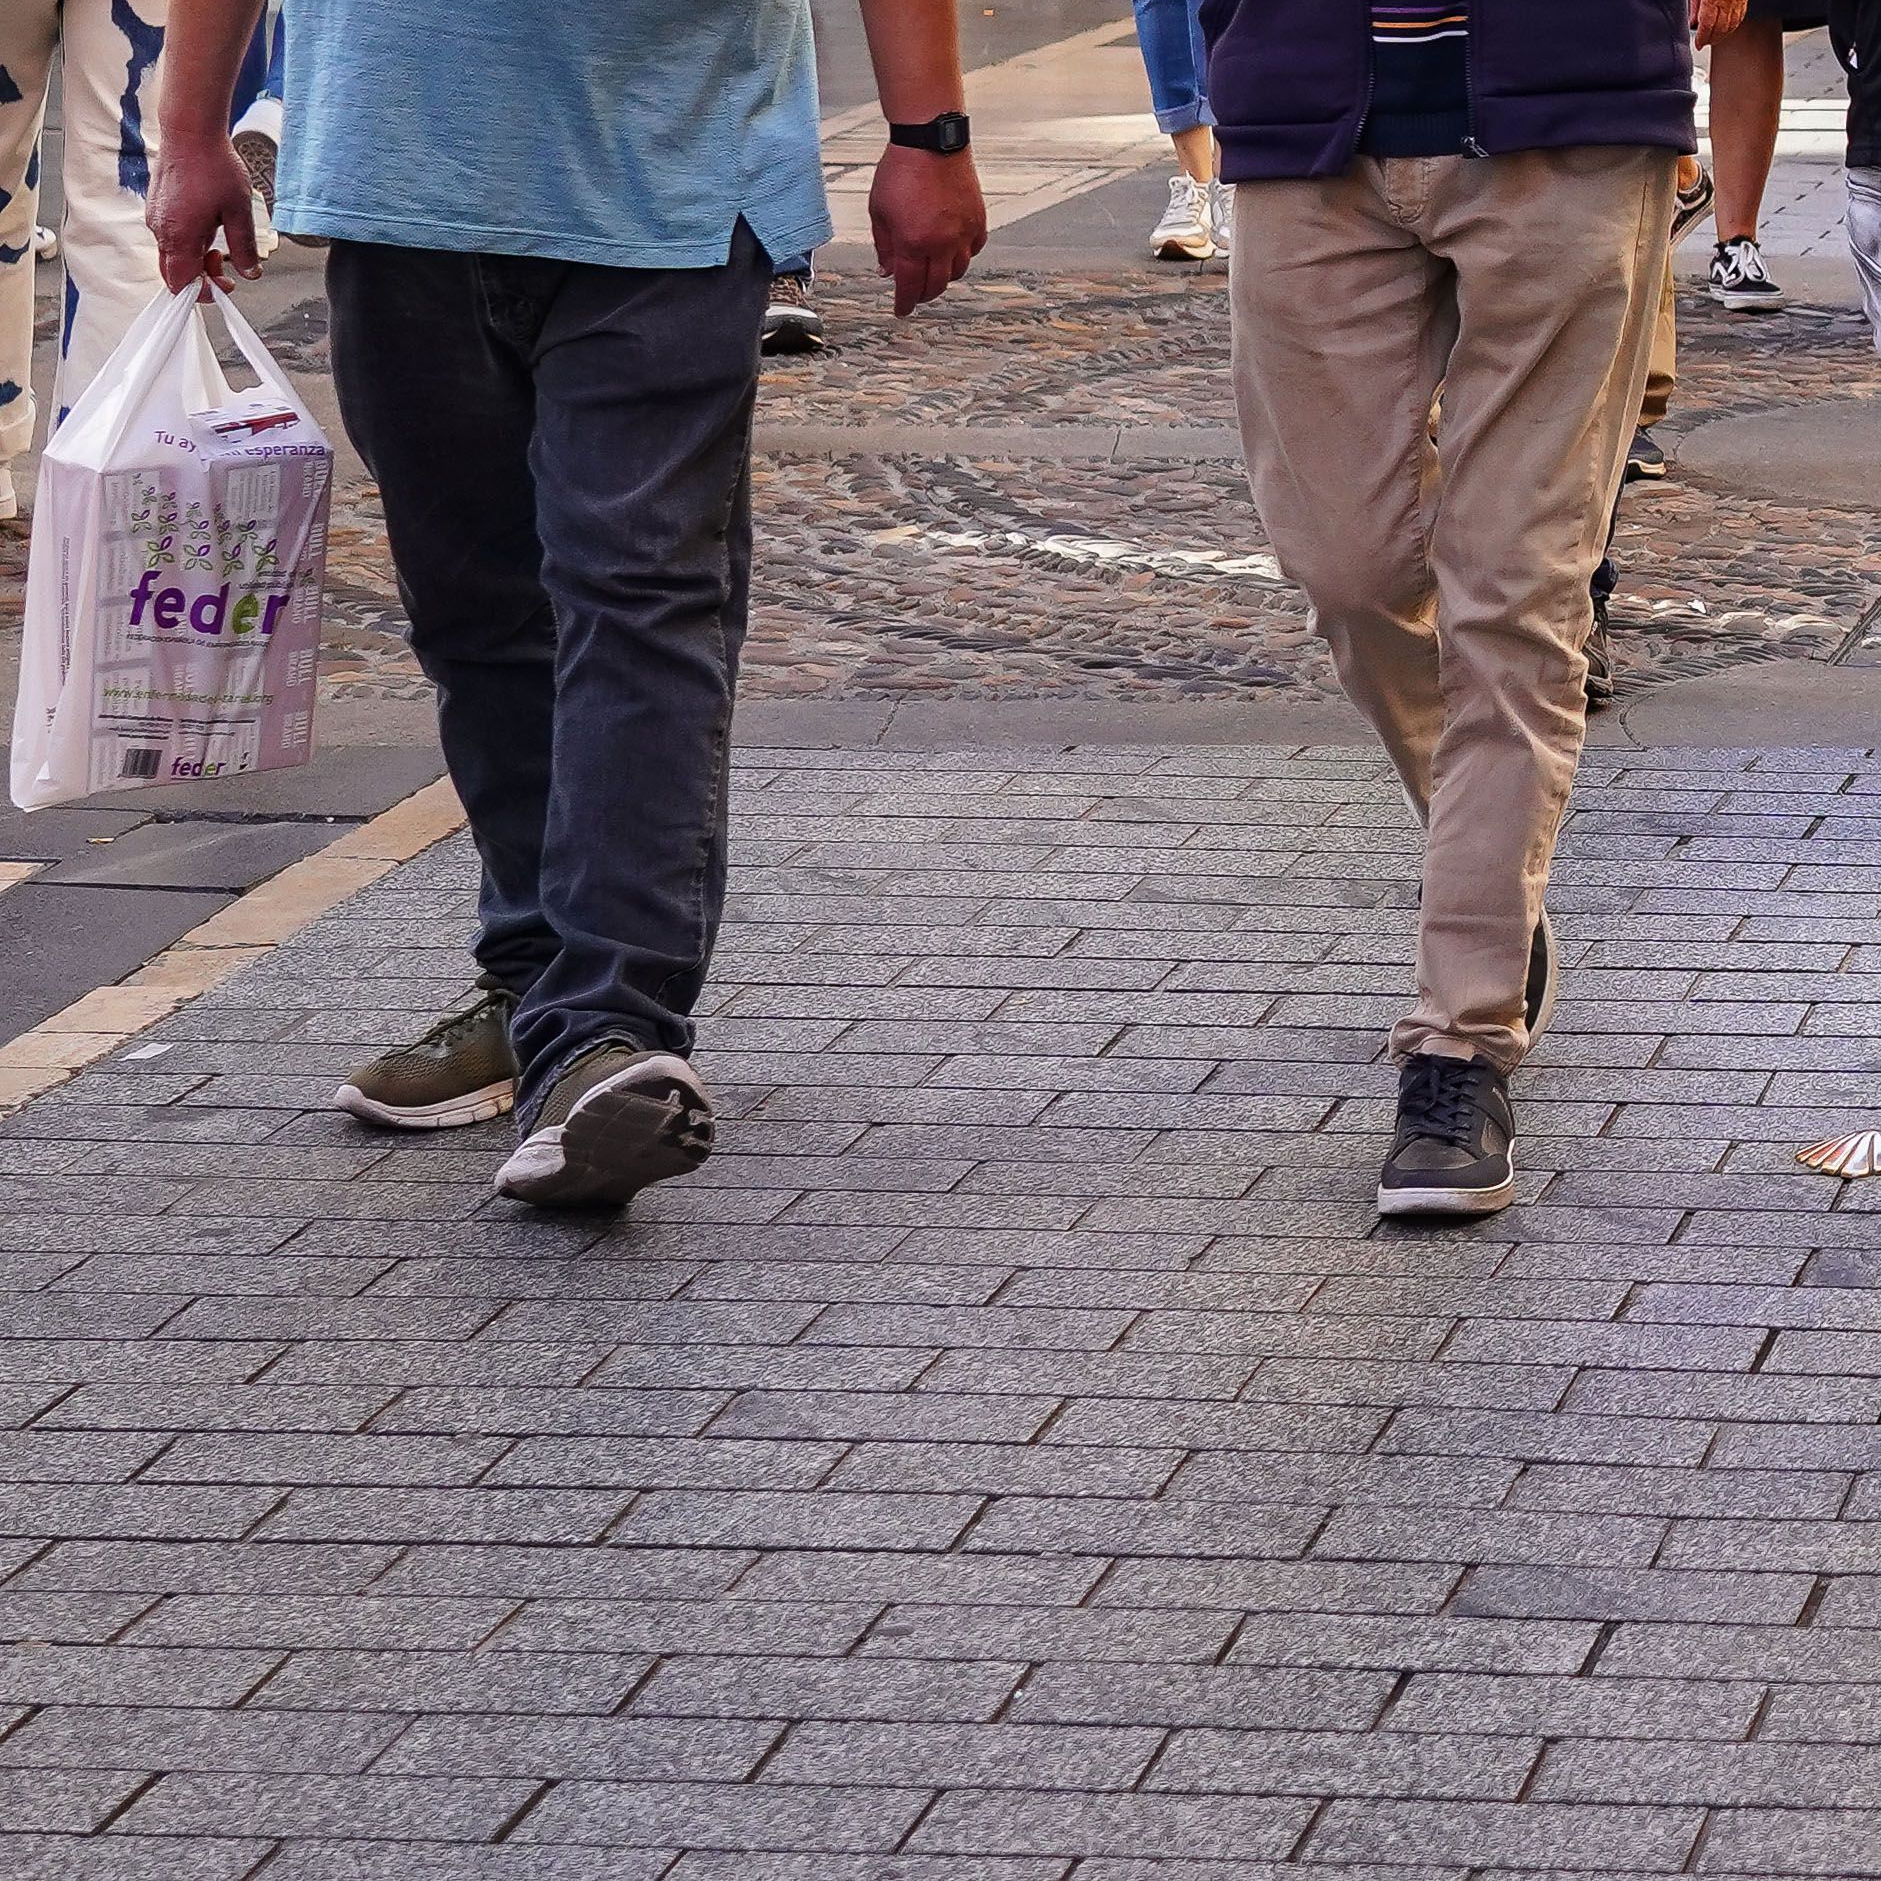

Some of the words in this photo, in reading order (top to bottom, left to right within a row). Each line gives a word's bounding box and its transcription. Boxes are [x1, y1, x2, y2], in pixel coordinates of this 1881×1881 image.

[154, 430, 175, 445] Tu
[178, 437, 197, 453] ay
[129, 570, 291, 636] feder
[170, 756, 227, 777] feder
